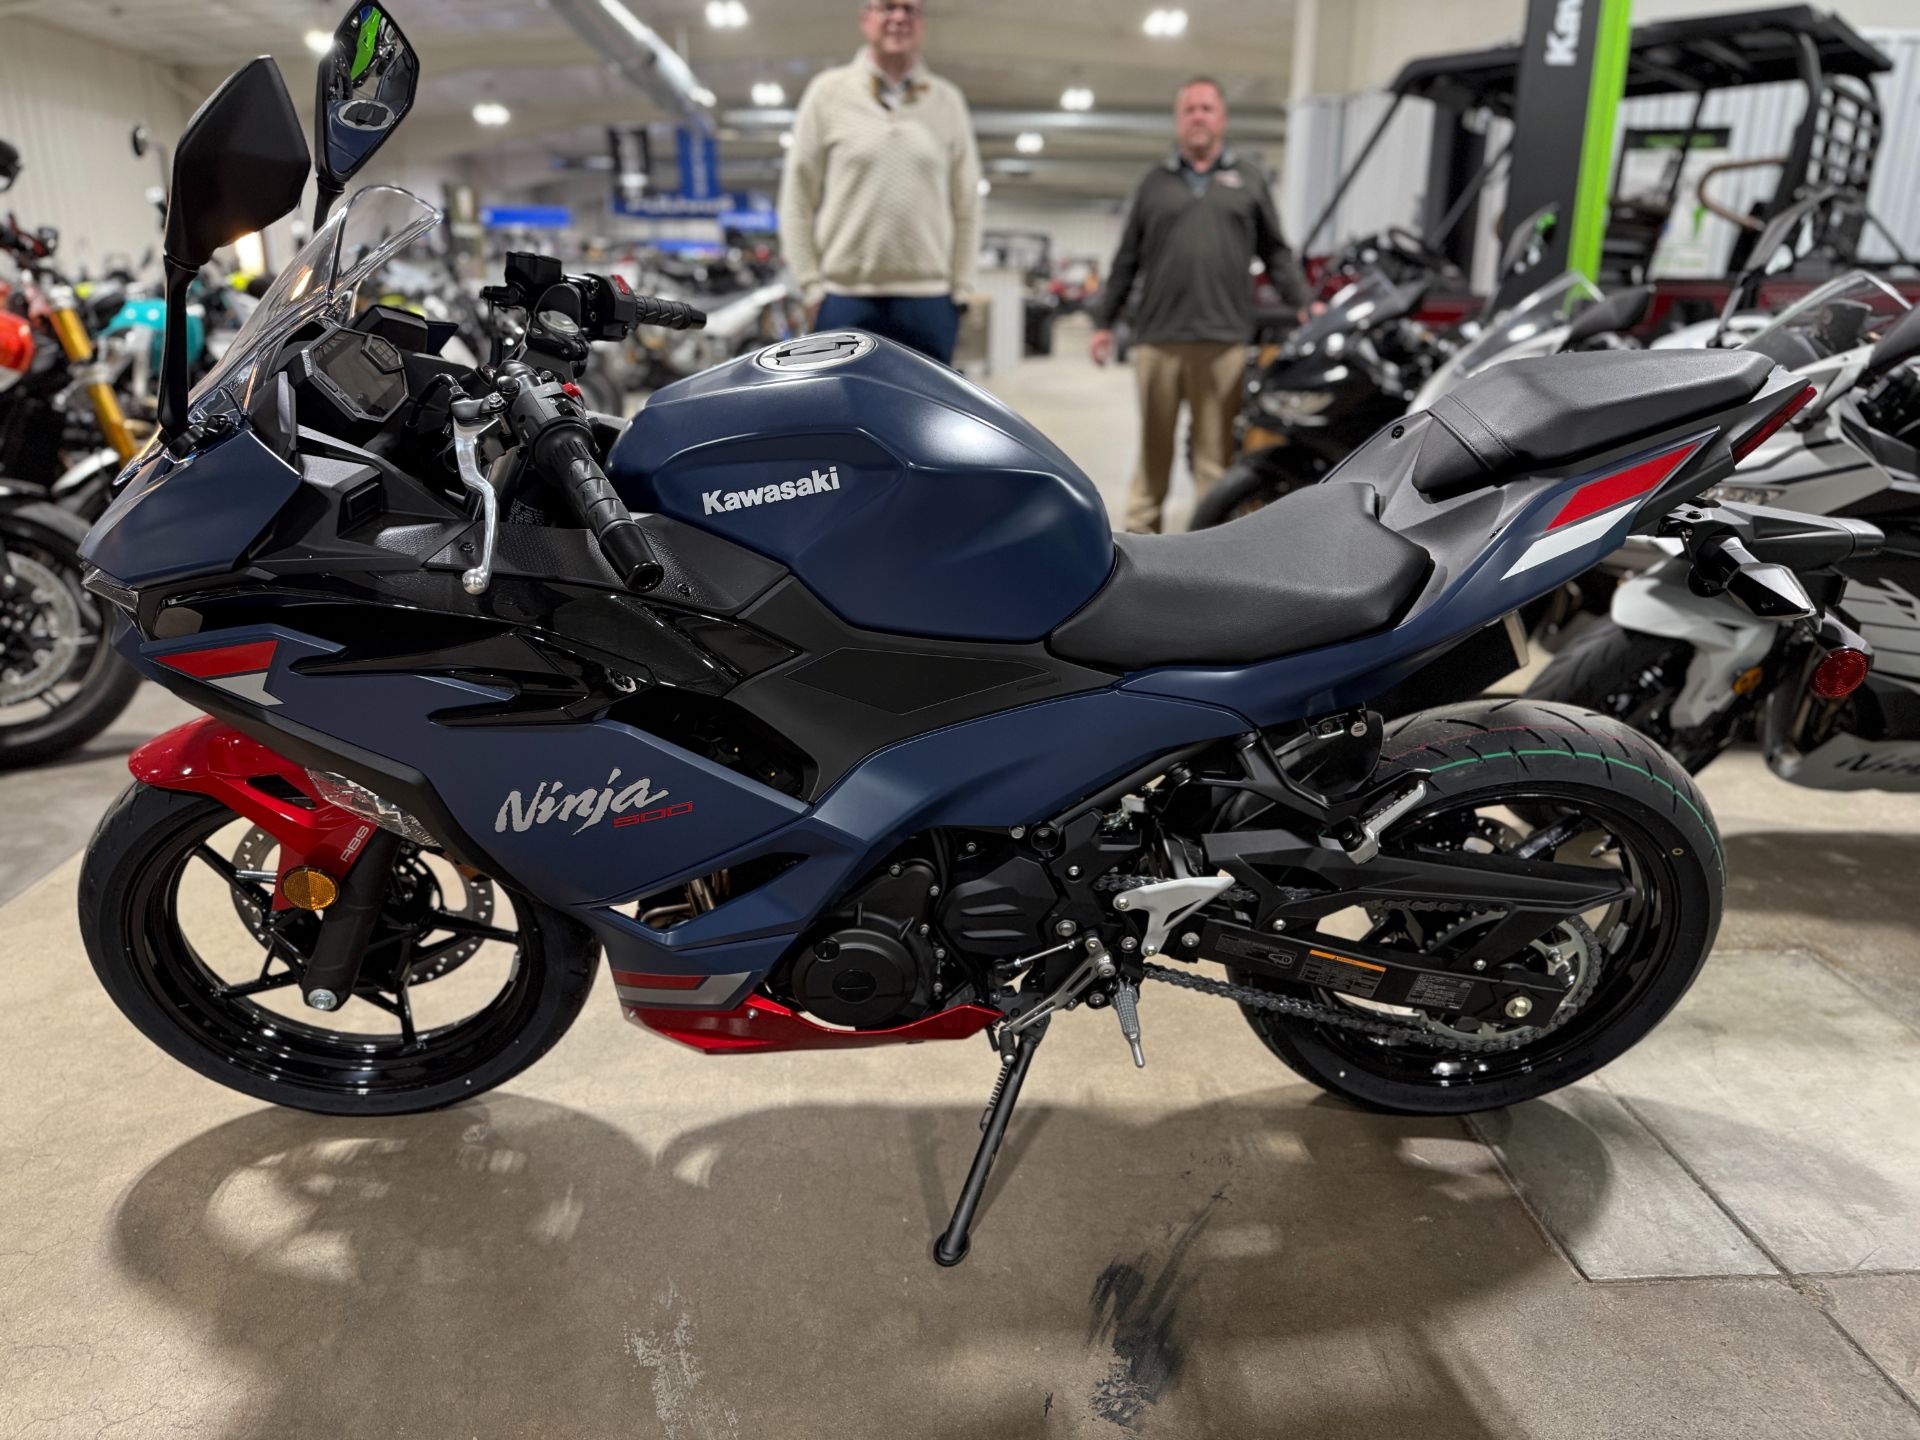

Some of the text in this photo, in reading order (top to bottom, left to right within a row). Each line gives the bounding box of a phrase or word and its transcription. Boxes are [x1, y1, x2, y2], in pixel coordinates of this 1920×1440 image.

[702, 466, 841, 515] Kawasaki
[494, 768, 669, 836] Ninja
[613, 801, 694, 829] 500
[340, 825, 369, 862] ABS
